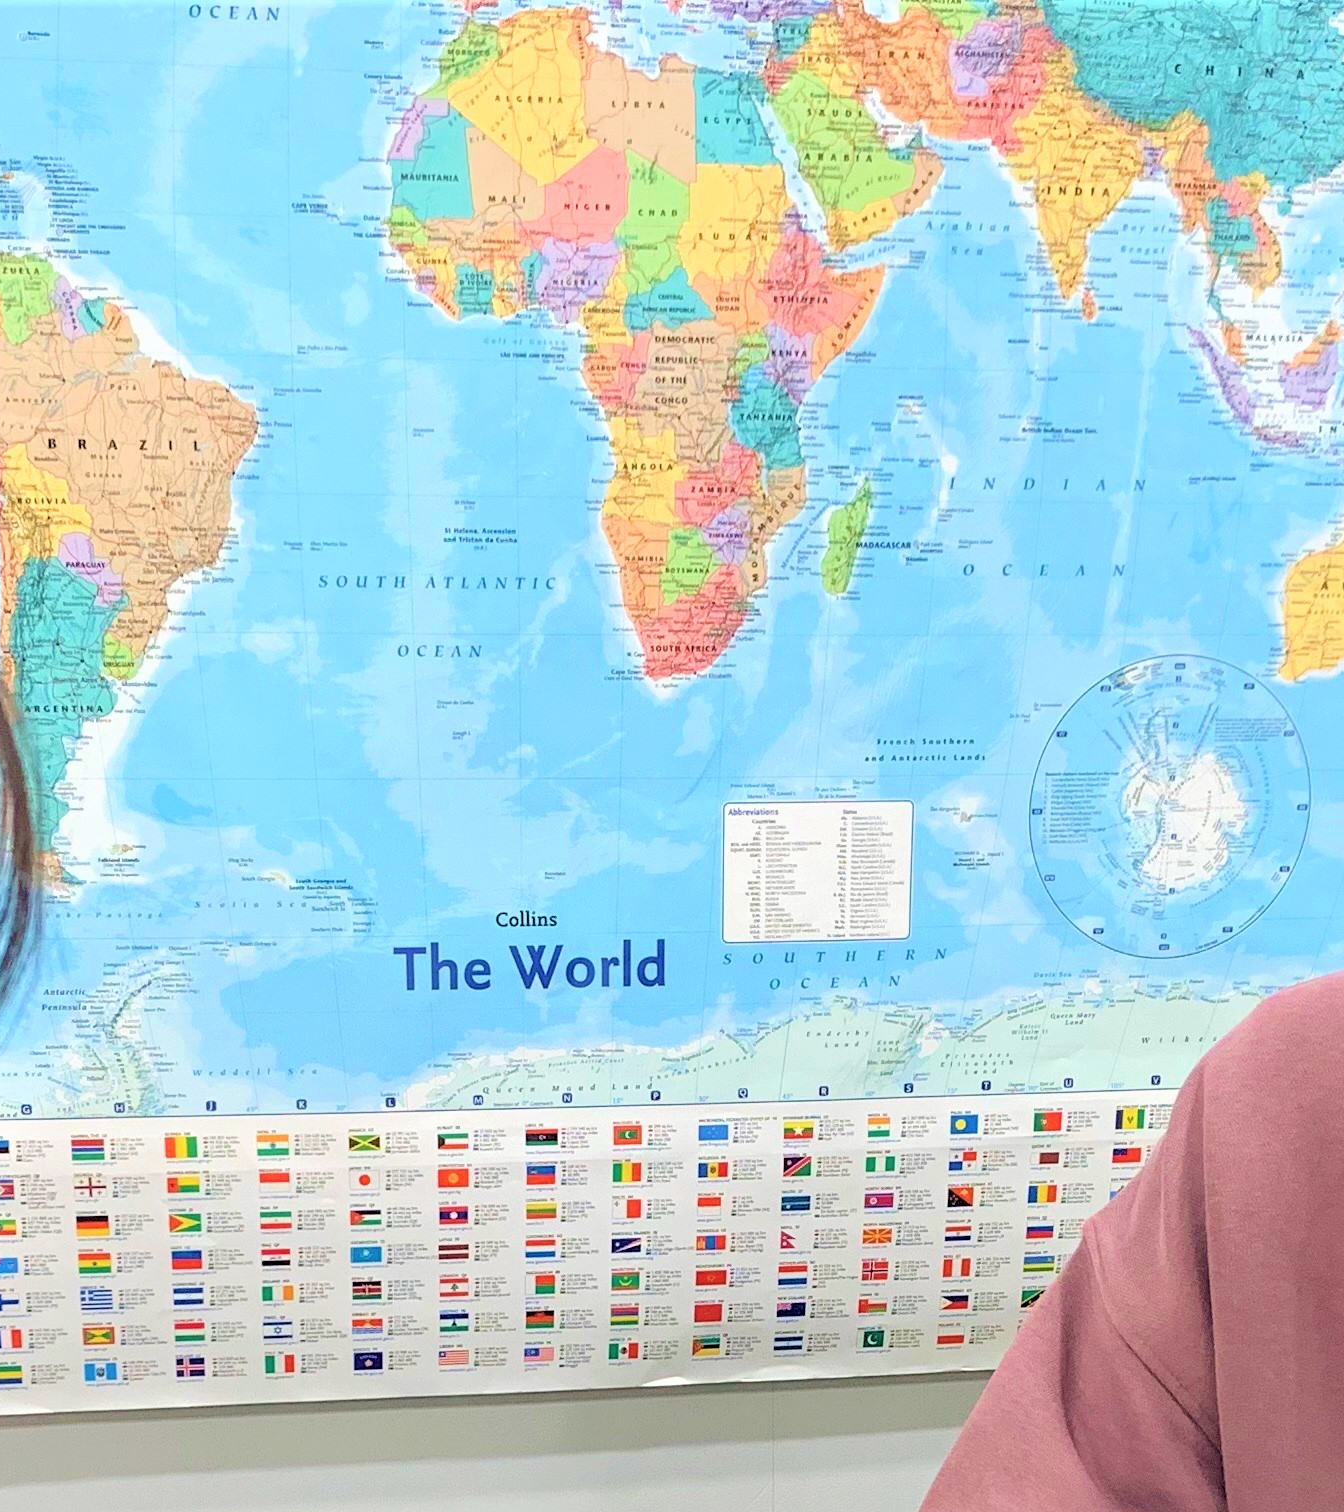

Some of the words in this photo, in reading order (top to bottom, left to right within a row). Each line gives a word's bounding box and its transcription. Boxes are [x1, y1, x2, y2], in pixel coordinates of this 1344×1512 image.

[189, 4, 280, 21] OCEAN
[877, 51, 925, 59] IRAN
[1174, 64, 1305, 79] CHINA
[495, 96, 563, 104] ALGERIA
[612, 101, 665, 109] LIBYA
[401, 173, 459, 182] MAURITANIA
[1046, 186, 1110, 197] INDIA
[699, 233, 768, 242] SUDAN
[655, 336, 716, 344] DEMOCRATIC
[655, 356, 698, 364] REPUBLIC
[669, 376, 687, 384] THE
[655, 397, 688, 405] CONGO
[740, 414, 793, 422] TANZANIA
[48, 439, 201, 451] BRAZIL
[623, 463, 674, 472] ANGOLA
[949, 477, 1146, 492] INDIAN
[17, 497, 67, 505] BOLIVIA
[856, 541, 912, 549] MADAGASCAR
[962, 564, 1125, 577] OCEAN
[318, 575, 406, 589] SOUTH
[425, 576, 556, 590] ATLANTIC
[397, 645, 483, 658] OCEAN
[24, 705, 103, 713] ARGENTINA
[728, 808, 779, 816] Abbreviations
[496, 911, 558, 928] Collins
[723, 948, 947, 965] SOUTHERN
[393, 942, 491, 991] The
[509, 939, 666, 990] World
[770, 976, 901, 989] OCEAN
